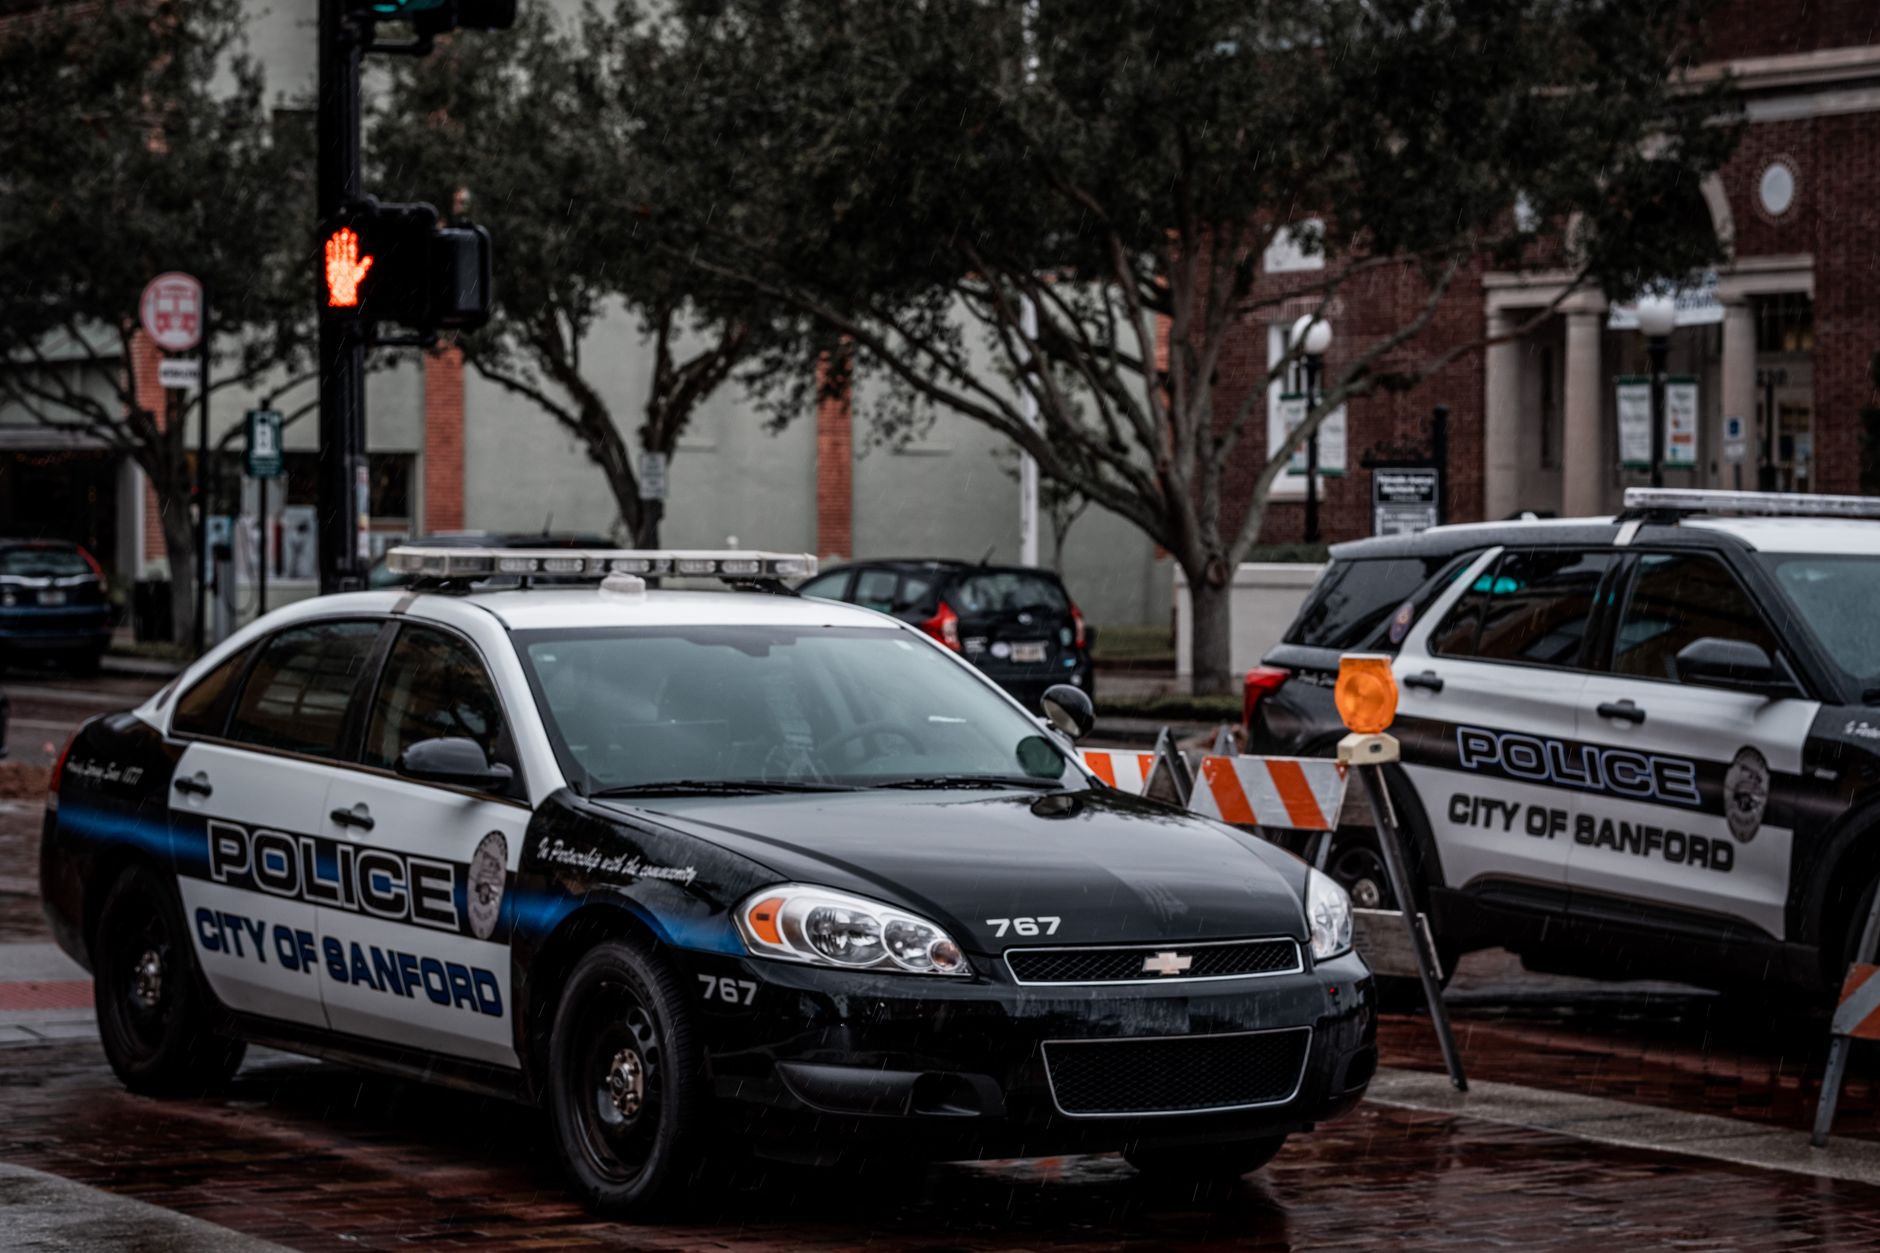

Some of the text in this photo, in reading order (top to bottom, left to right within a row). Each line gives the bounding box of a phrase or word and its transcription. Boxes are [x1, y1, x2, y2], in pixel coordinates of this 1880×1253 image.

[1456, 725, 1701, 805] POLICE
[600, 852, 629, 872] with
[621, 855, 641, 876] the
[1448, 793, 1734, 873] CITY OF SANFORD
[207, 818, 461, 932] POLICE
[195, 907, 504, 1019] CITY OF SANFORD
[986, 916, 1062, 938] 767
[697, 973, 758, 1006] 767
